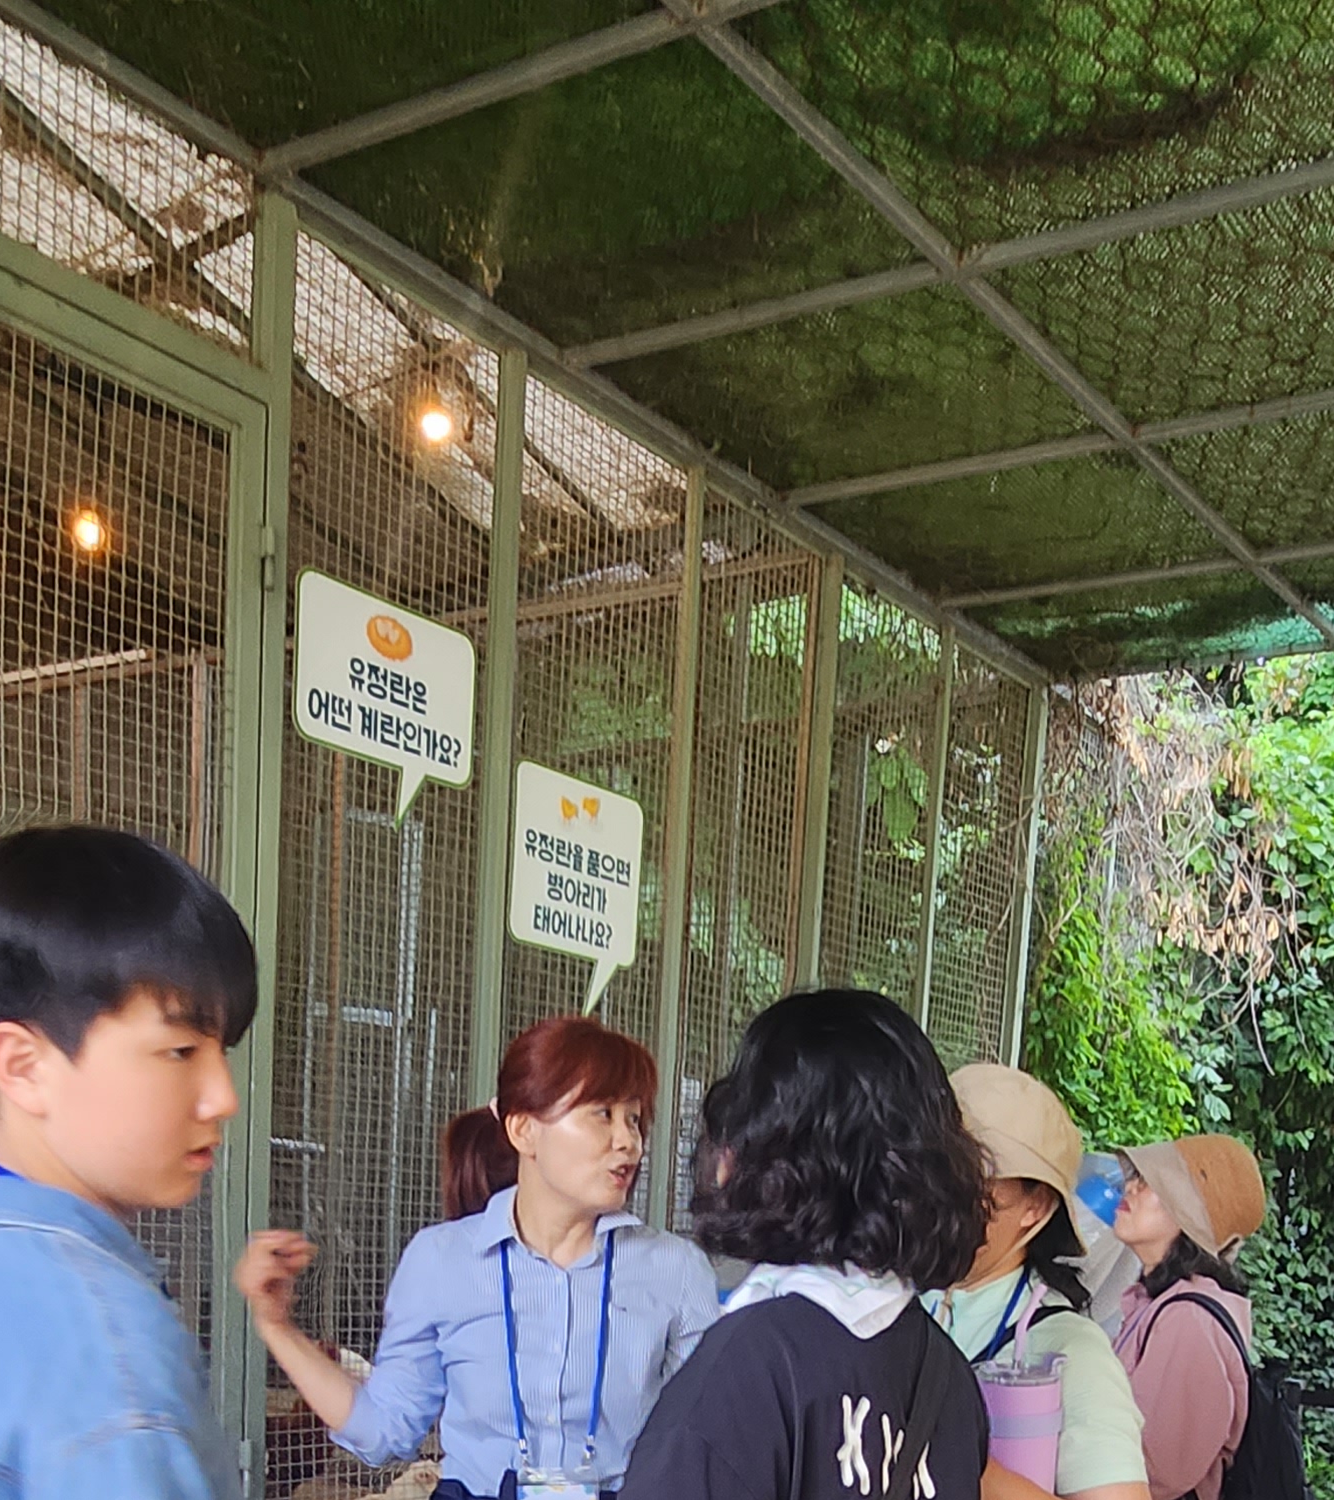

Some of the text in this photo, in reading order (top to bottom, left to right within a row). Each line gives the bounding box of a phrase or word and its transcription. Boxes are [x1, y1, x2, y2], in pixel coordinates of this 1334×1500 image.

[349, 657, 428, 715] 유정란은
[308, 687, 461, 768] 어떤 계란인가요?
[524, 829, 631, 886] 유정란을 품으면
[547, 871, 608, 915] 병아리가
[533, 905, 612, 950] 태어나나요?
